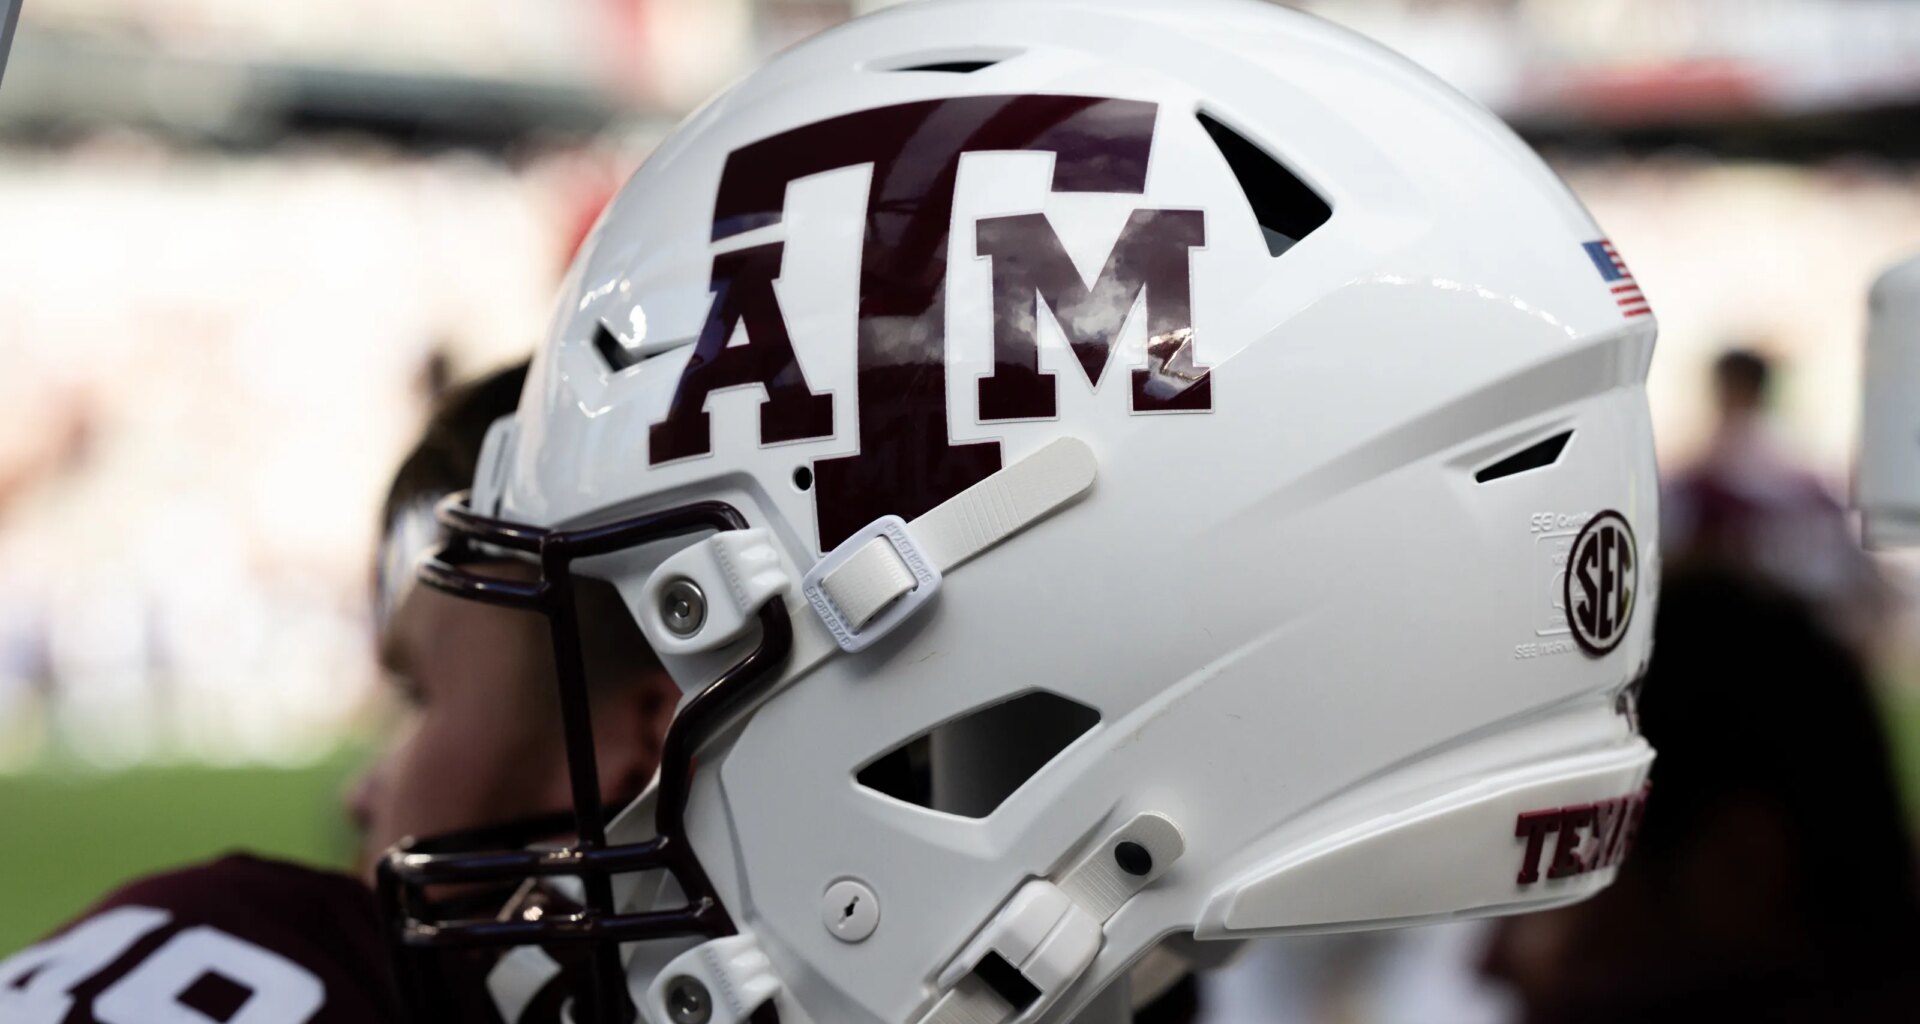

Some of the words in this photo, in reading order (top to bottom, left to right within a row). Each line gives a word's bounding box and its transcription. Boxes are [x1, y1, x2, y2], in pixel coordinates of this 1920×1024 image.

[885, 521, 934, 584] SPORTSTAR
[1576, 526, 1632, 640] SEC
[806, 585, 851, 647] SPORTSTAR
